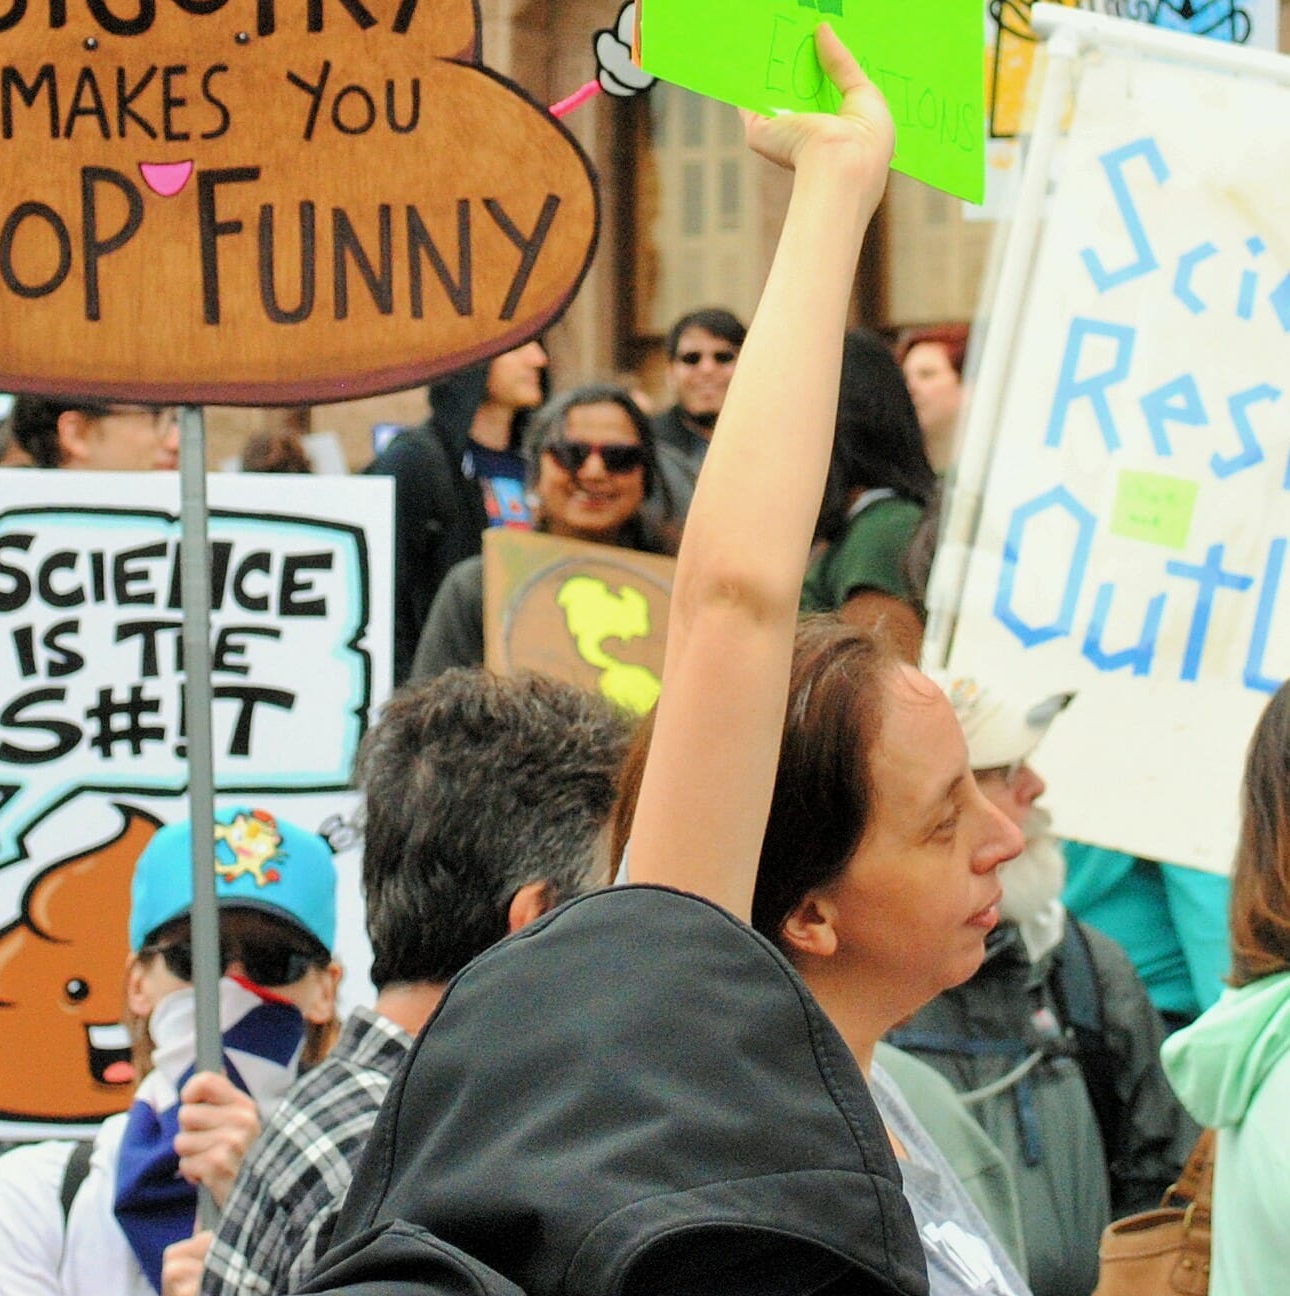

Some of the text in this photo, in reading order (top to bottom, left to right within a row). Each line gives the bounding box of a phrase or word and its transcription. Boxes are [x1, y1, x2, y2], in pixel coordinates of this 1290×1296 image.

[0, 60, 423, 141] MAKES YOU
[765, 13, 975, 152] EQTIONS
[193, 166, 562, 326] FUNNY
[12, 618, 85, 678] IS
